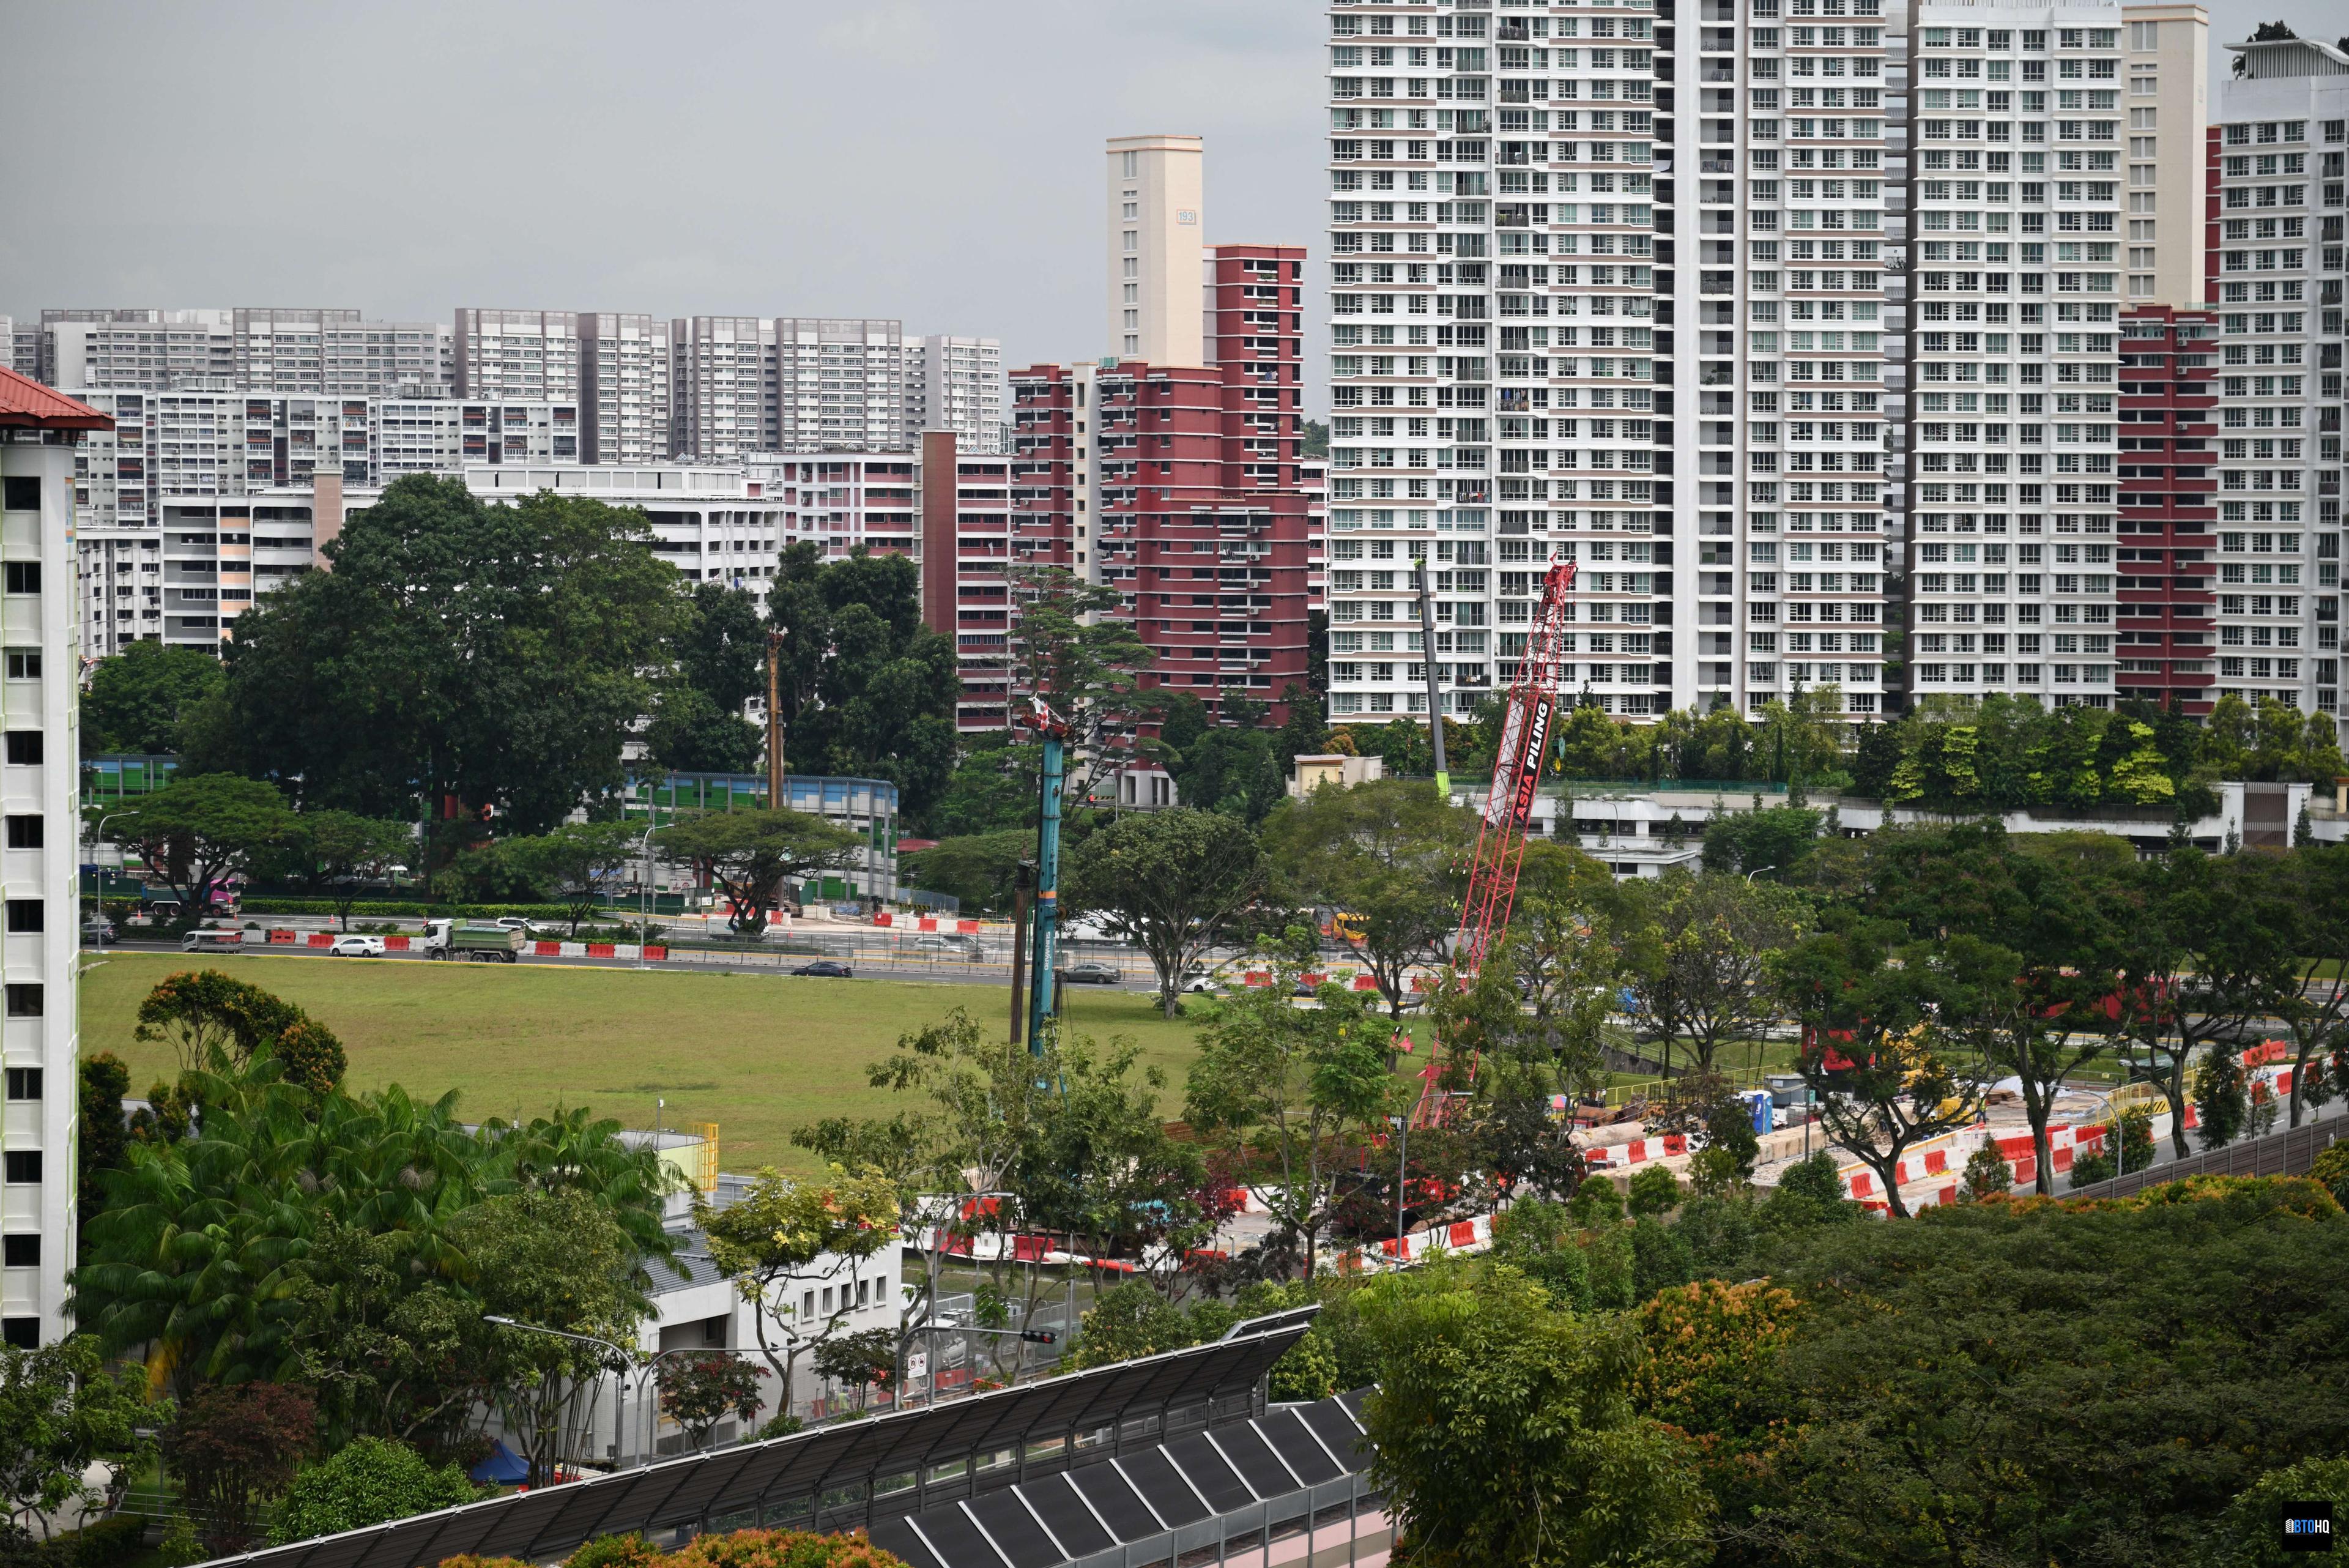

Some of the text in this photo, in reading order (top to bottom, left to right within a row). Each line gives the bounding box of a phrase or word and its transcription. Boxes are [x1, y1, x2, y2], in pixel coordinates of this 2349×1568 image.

[1179, 211, 1193, 221] 193
[1551, 623, 1560, 658] SANY
[1516, 702, 1548, 821] ASIA PILING
